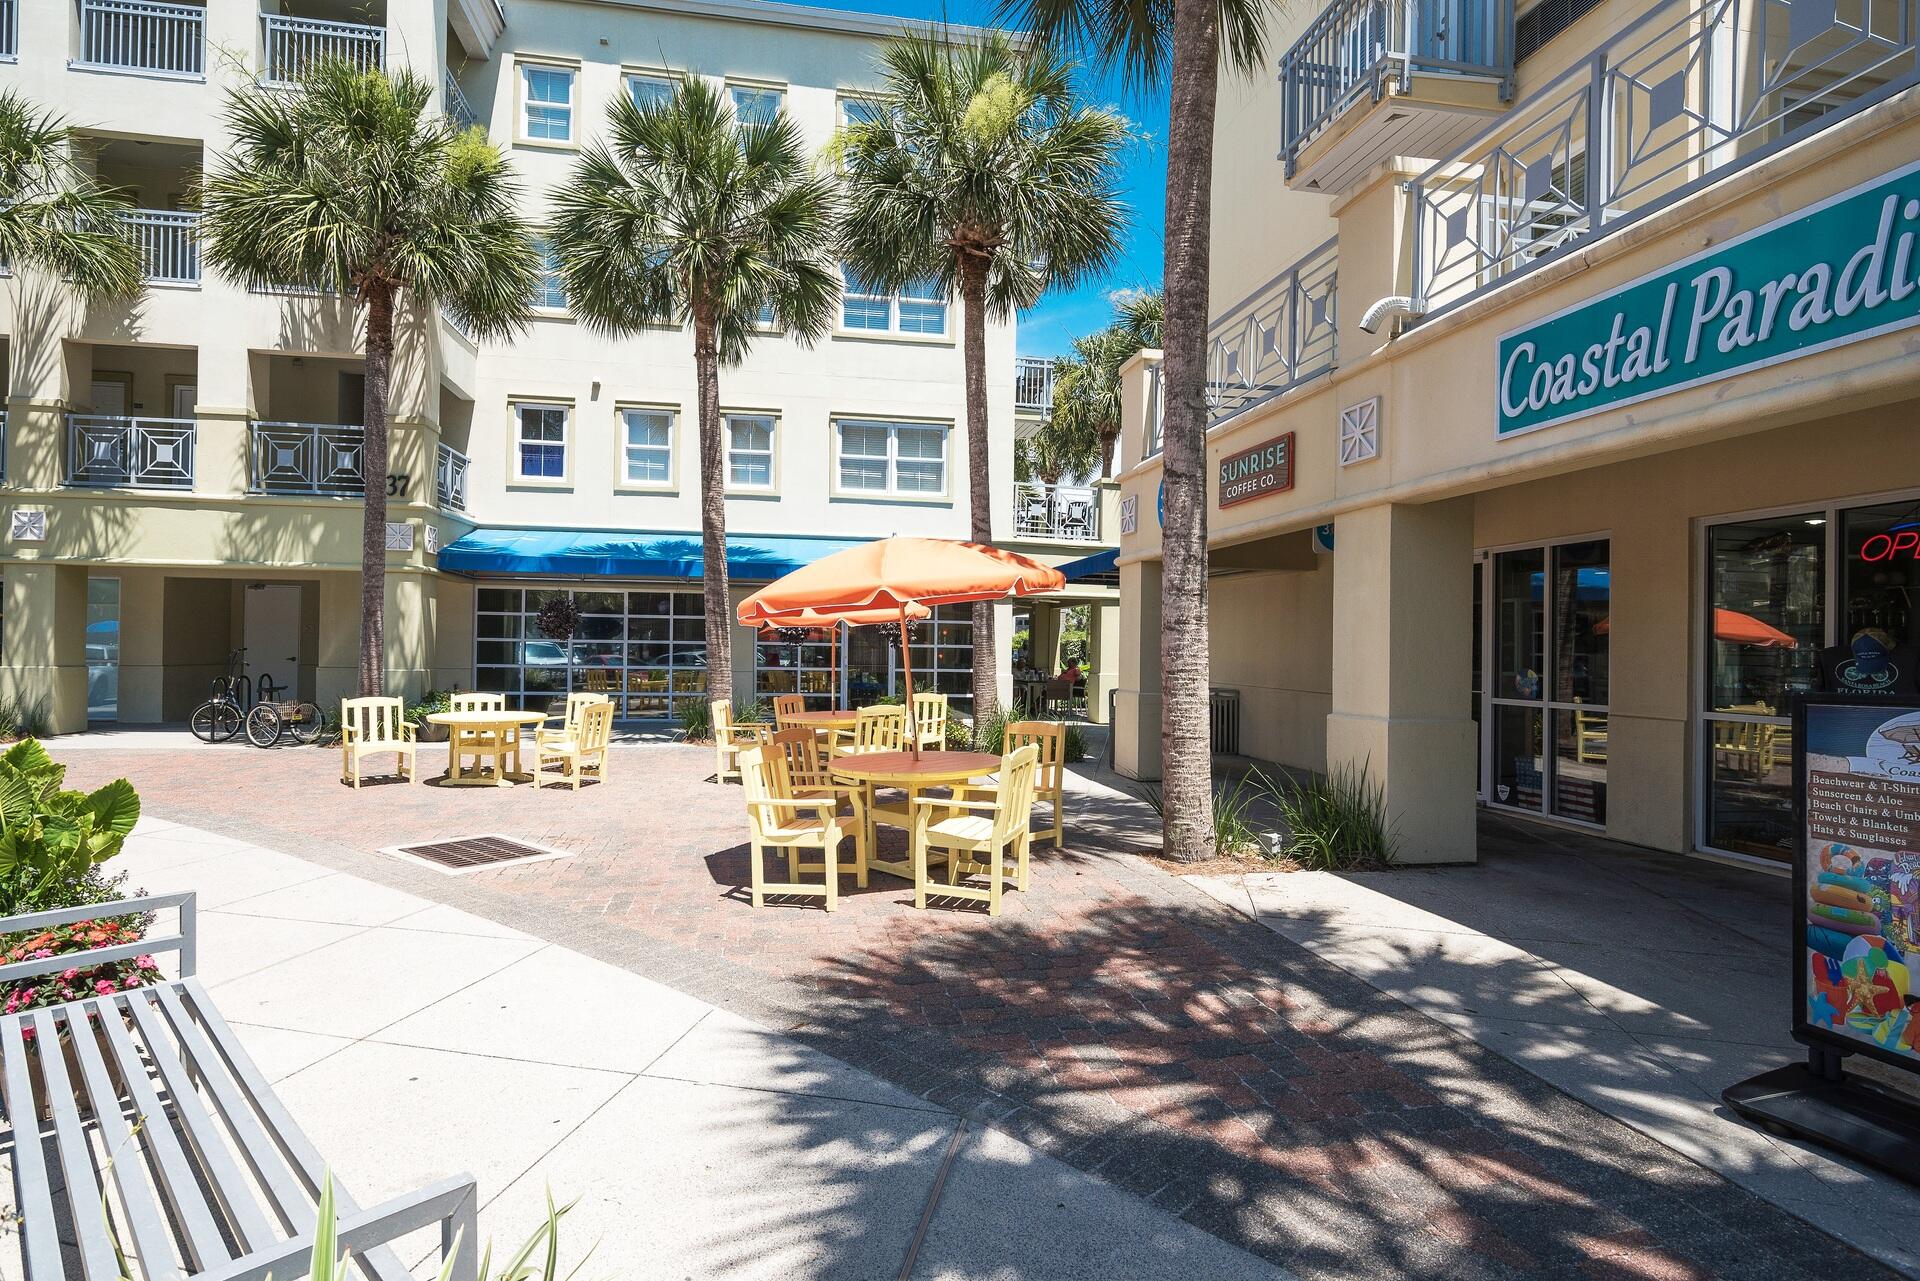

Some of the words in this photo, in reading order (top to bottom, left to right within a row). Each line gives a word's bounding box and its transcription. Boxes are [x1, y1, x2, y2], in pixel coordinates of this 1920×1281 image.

[1501, 282, 1679, 418] Coastal
[1684, 193, 1920, 364] Paradi
[1221, 443, 1285, 484] SUNRISE
[1226, 480, 1257, 498] COFFEE
[1260, 474, 1277, 488] CO.
[1812, 775, 1865, 789] Beachwear
[1868, 782, 1878, 790] &
[1812, 787, 1861, 801] Sunscreen
[1865, 793, 1874, 802] &
[1877, 795, 1903, 806] Aloe
[1813, 800, 1841, 811] Beach
[1845, 804, 1878, 816] Chairs
[1881, 808, 1891, 818] &
[1813, 811, 1846, 824] Towels
[1849, 817, 1859, 826] &
[1862, 818, 1909, 833] Blankets
[1813, 824, 1834, 835] Hats
[1837, 828, 1846, 837] &
[1849, 830, 1907, 846] Sunglasses
